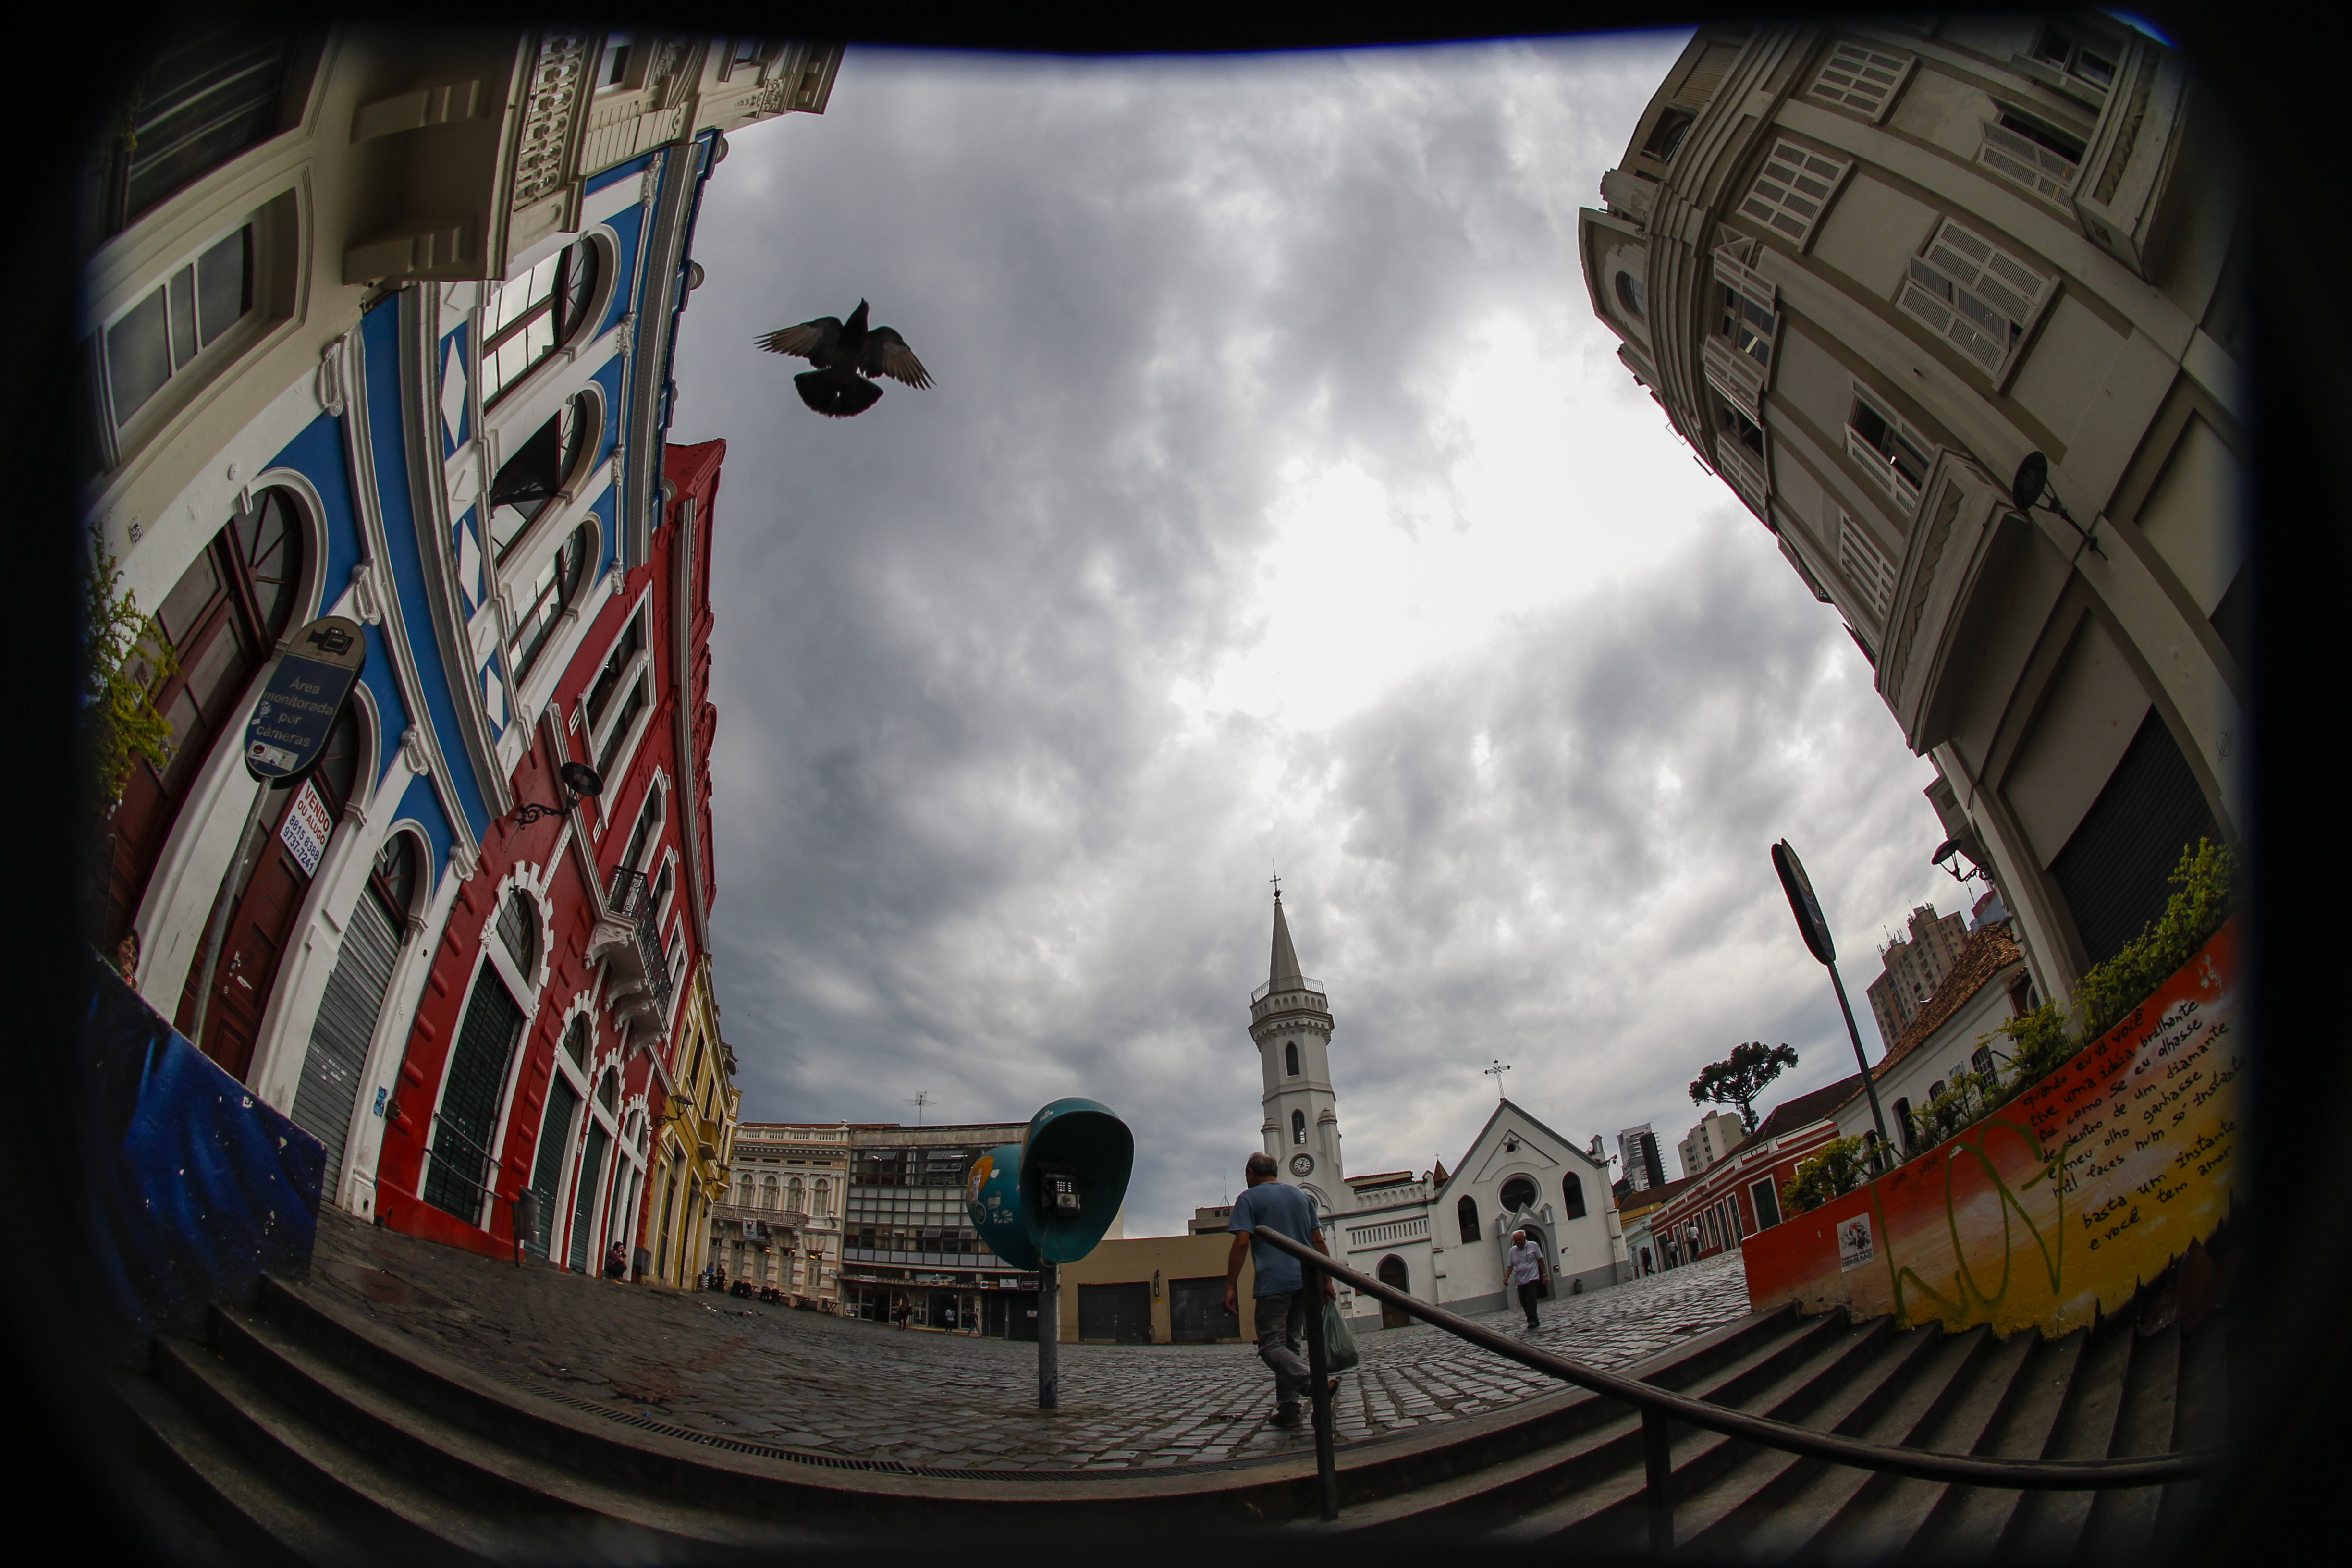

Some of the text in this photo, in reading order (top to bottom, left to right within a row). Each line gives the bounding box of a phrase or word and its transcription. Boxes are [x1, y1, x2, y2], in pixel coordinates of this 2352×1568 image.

[263, 691, 334, 716] monitorada
[277, 712, 303, 725] por
[289, 676, 320, 695] Área
[257, 724, 311, 747] câmeras
[289, 814, 319, 861] 8815 8388
[297, 800, 325, 845] OU ALUGO
[305, 784, 330, 832] VENDO
[283, 826, 315, 872] 9737-7241
[2023, 1007, 2145, 1110] quando eu vi você
[2030, 1105, 2059, 1127] tive
[2064, 1078, 2097, 1103] uma
[2140, 1001, 2199, 1048] brilhante
[2039, 1125, 2059, 1143] foi
[2067, 1098, 2102, 1124] como
[2135, 1058, 2151, 1075] eu
[2158, 1019, 2203, 1057] olhasse
[2043, 1022, 2229, 1164] de dentro de um diamante
[2048, 1071, 2203, 1179] e meu olho ganhasse
[2052, 1055, 2247, 1198] mil faces num só instante
[2082, 1120, 2237, 1229] basta um instante
[2090, 1146, 2233, 1250] e você tem amor
